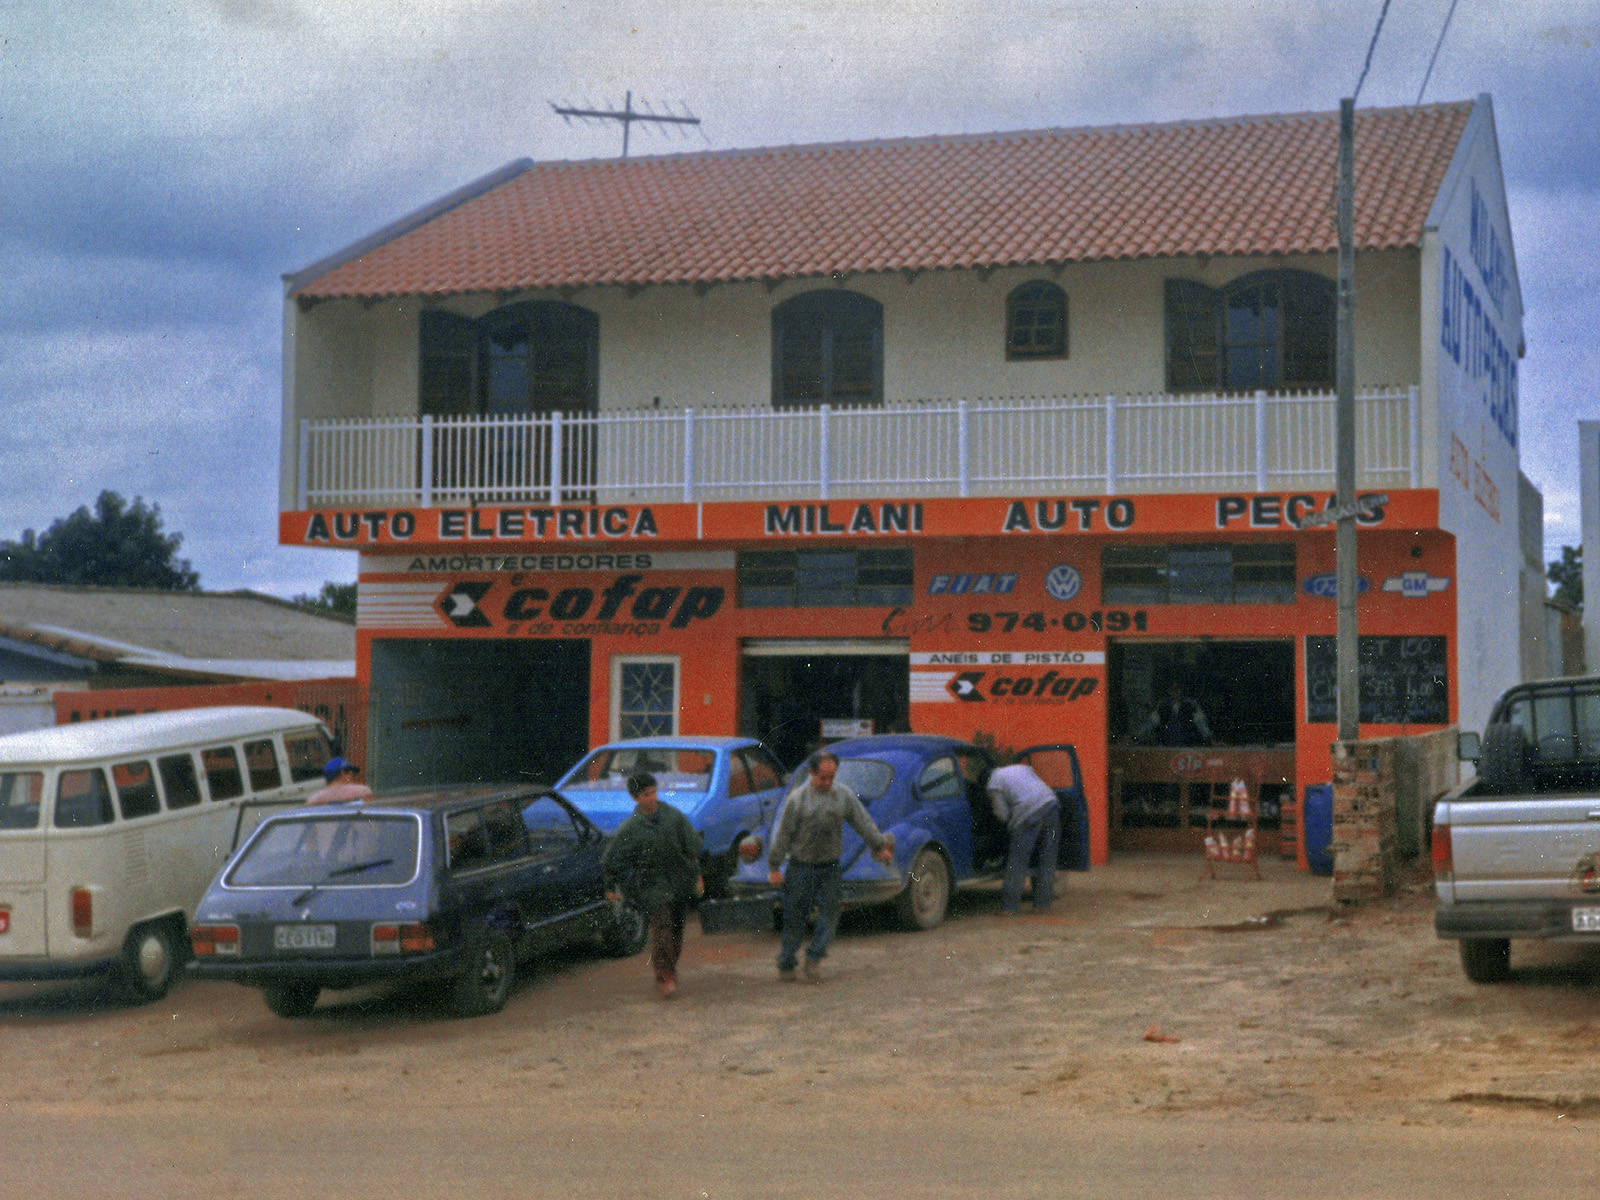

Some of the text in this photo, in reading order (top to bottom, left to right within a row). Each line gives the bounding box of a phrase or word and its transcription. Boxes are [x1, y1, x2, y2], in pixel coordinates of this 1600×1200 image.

[305, 507, 659, 542] AUTO ELETRICA
[764, 502, 923, 536] MILANI
[1002, 498, 1136, 533] AUTO
[408, 553, 653, 573] AMORTECEDORES
[926, 573, 1019, 595] FIAT
[1403, 579, 1426, 592] GM
[502, 574, 726, 630] cofap
[561, 620, 661, 638] confiança
[990, 652, 1013, 664] DE
[1024, 651, 1085, 664] PISTÃO
[988, 670, 1099, 701] cofap
